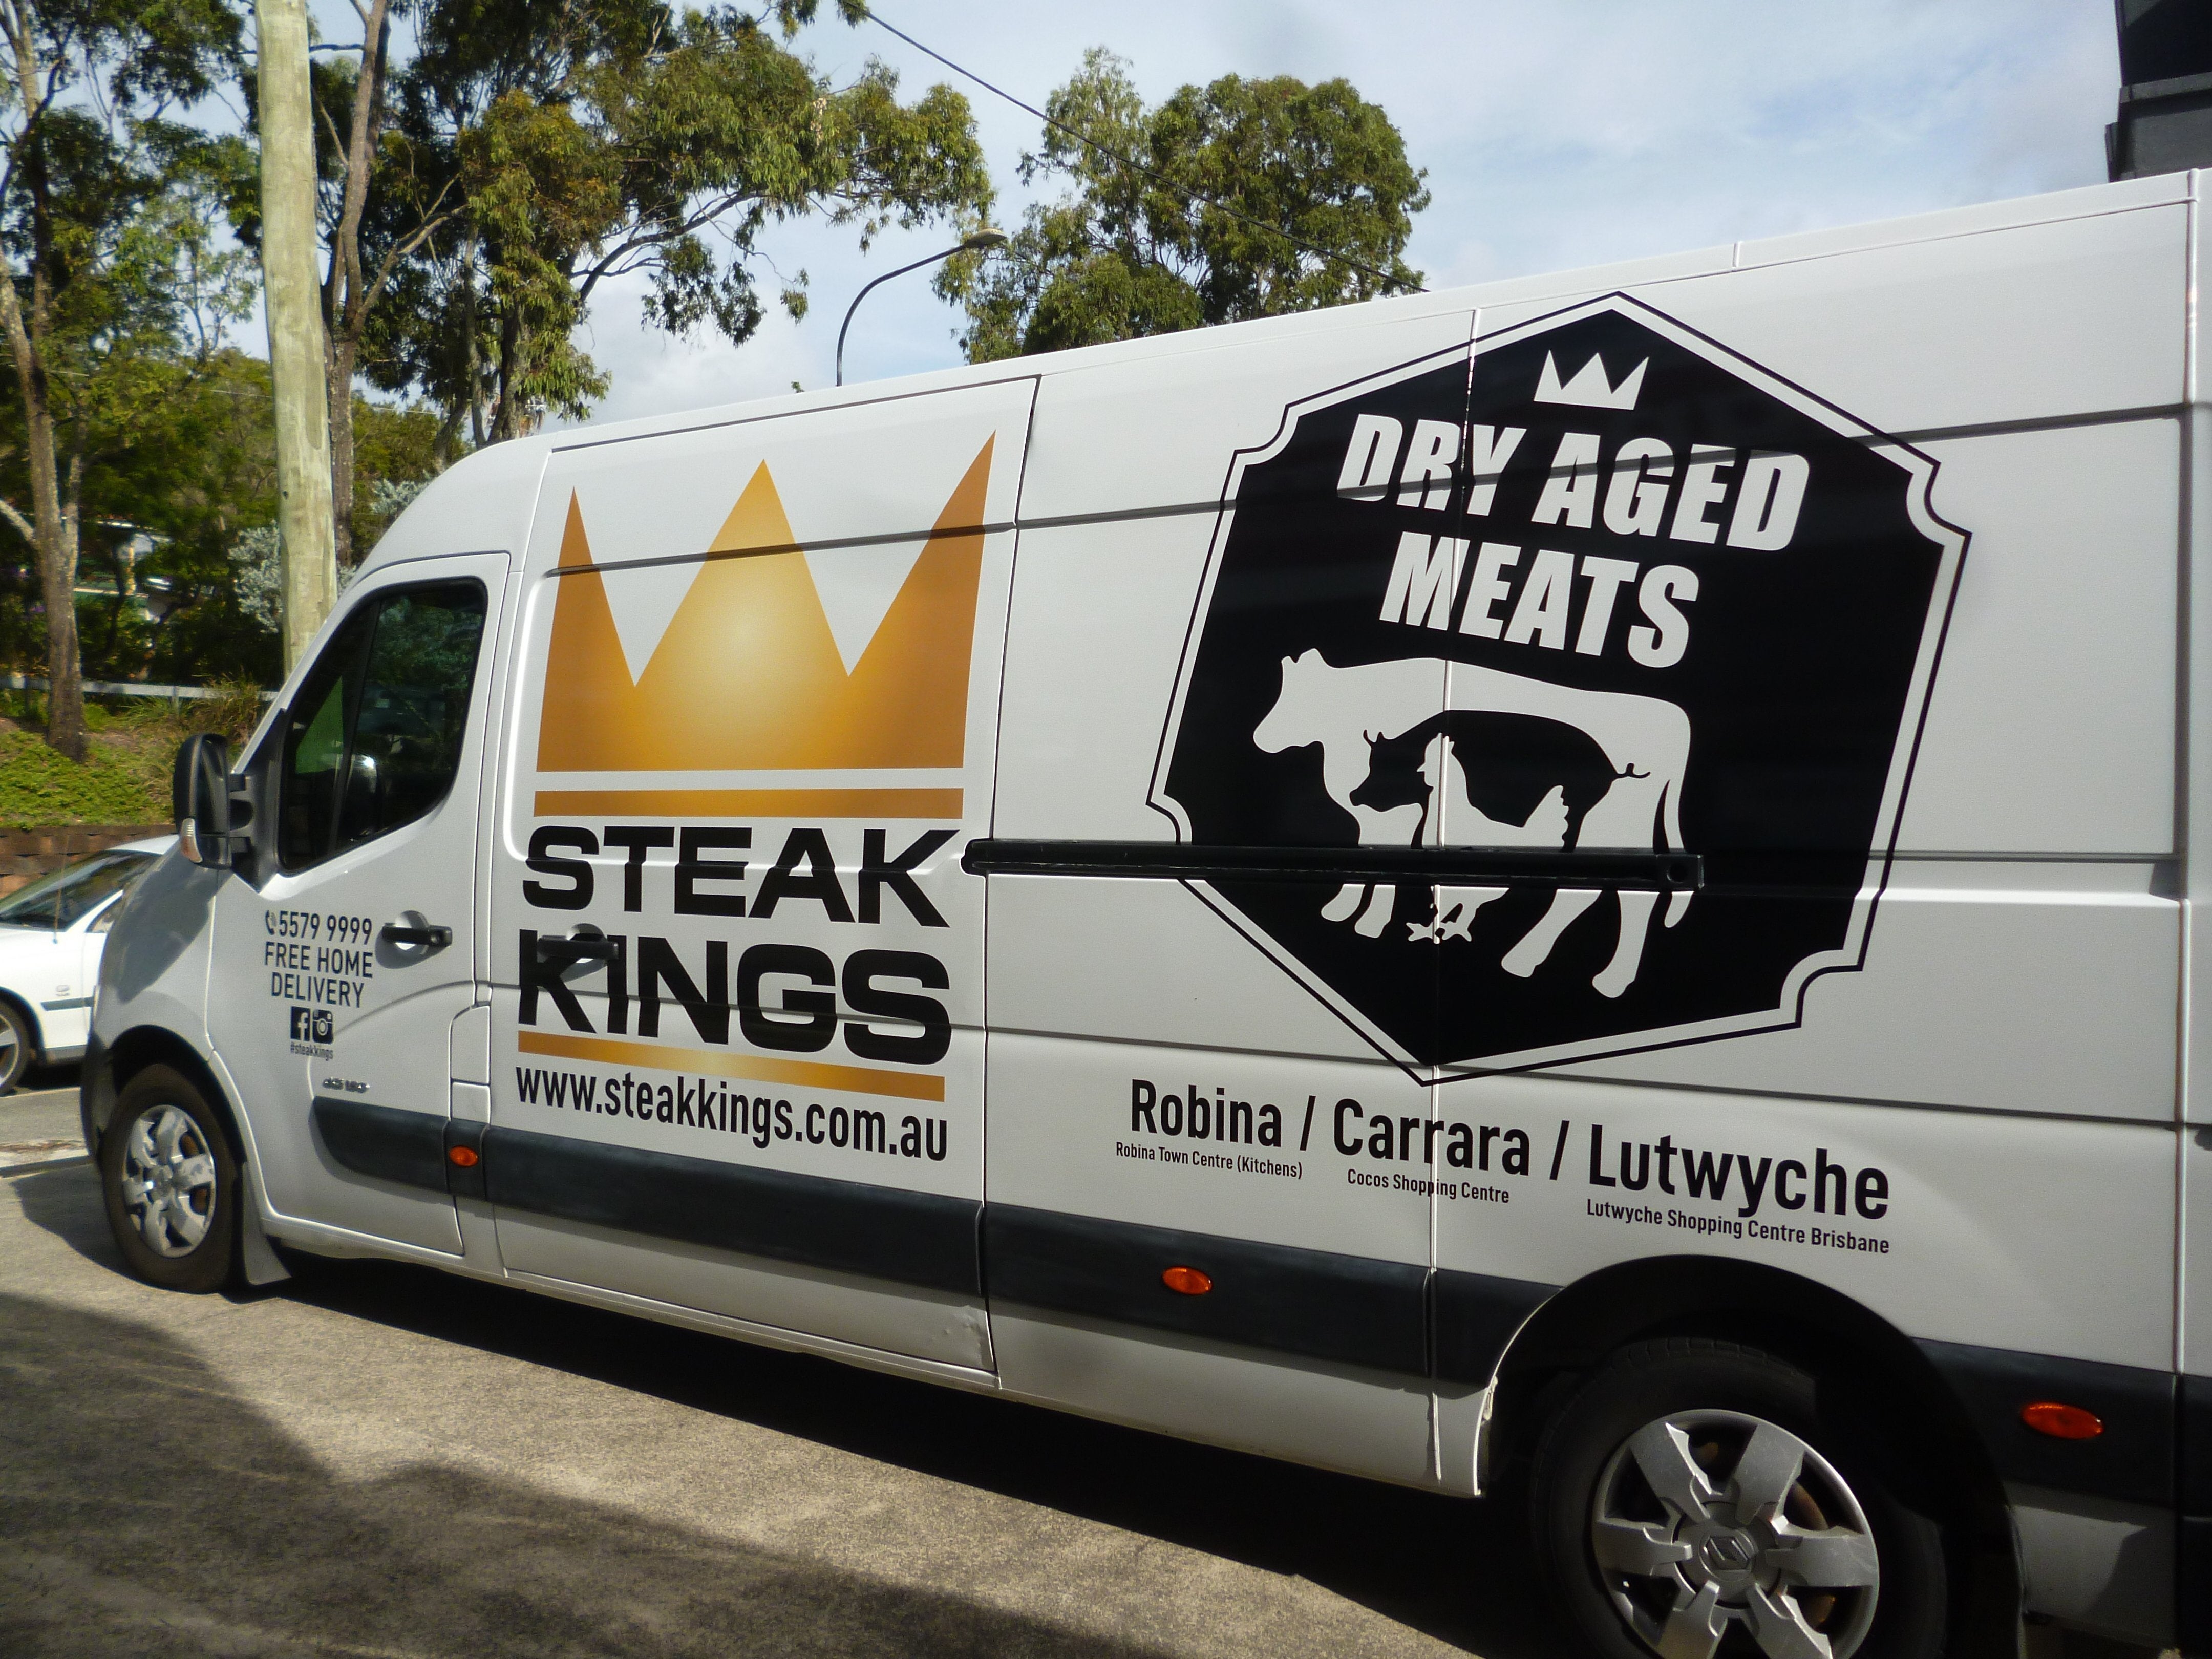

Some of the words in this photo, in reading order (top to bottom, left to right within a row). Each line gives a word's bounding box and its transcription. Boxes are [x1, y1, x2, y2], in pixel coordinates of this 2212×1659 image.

[1337, 414, 1526, 516] DRY
[1531, 432, 1810, 551] AGED
[1379, 531, 1699, 668] MEATS
[523, 825, 960, 927] STEAK
[279, 910, 320, 940] 5579
[327, 915, 372, 945] 9999
[264, 942, 310, 970] FREE
[318, 947, 373, 978] HOME
[271, 972, 364, 1008] DELIVERY
[518, 929, 952, 1065] KINGS
[290, 1041, 333, 1061] #steakkings
[516, 1067, 947, 1161] www.steakkings.com.au
[1116, 1142, 1155, 1160] Robina
[1160, 1146, 1188, 1164] Town
[1192, 1151, 1233, 1169] Centre
[1237, 1155, 1303, 1180] (Kitchens)
[1132, 1079, 1282, 1147] Robina
[1333, 1098, 1530, 1176] Carrara
[1589, 1124, 1889, 1220] Lutwyche
[1347, 1168, 1389, 1188] Cocos
[1393, 1174, 1457, 1199] Shopping
[1461, 1183, 1509, 1204] Centre
[1587, 1198, 1662, 1225] Lutwyche
[1667, 1209, 1742, 1239] Shopping
[1748, 1220, 1805, 1244] Centre
[1812, 1227, 1889, 1254] Brisbane
